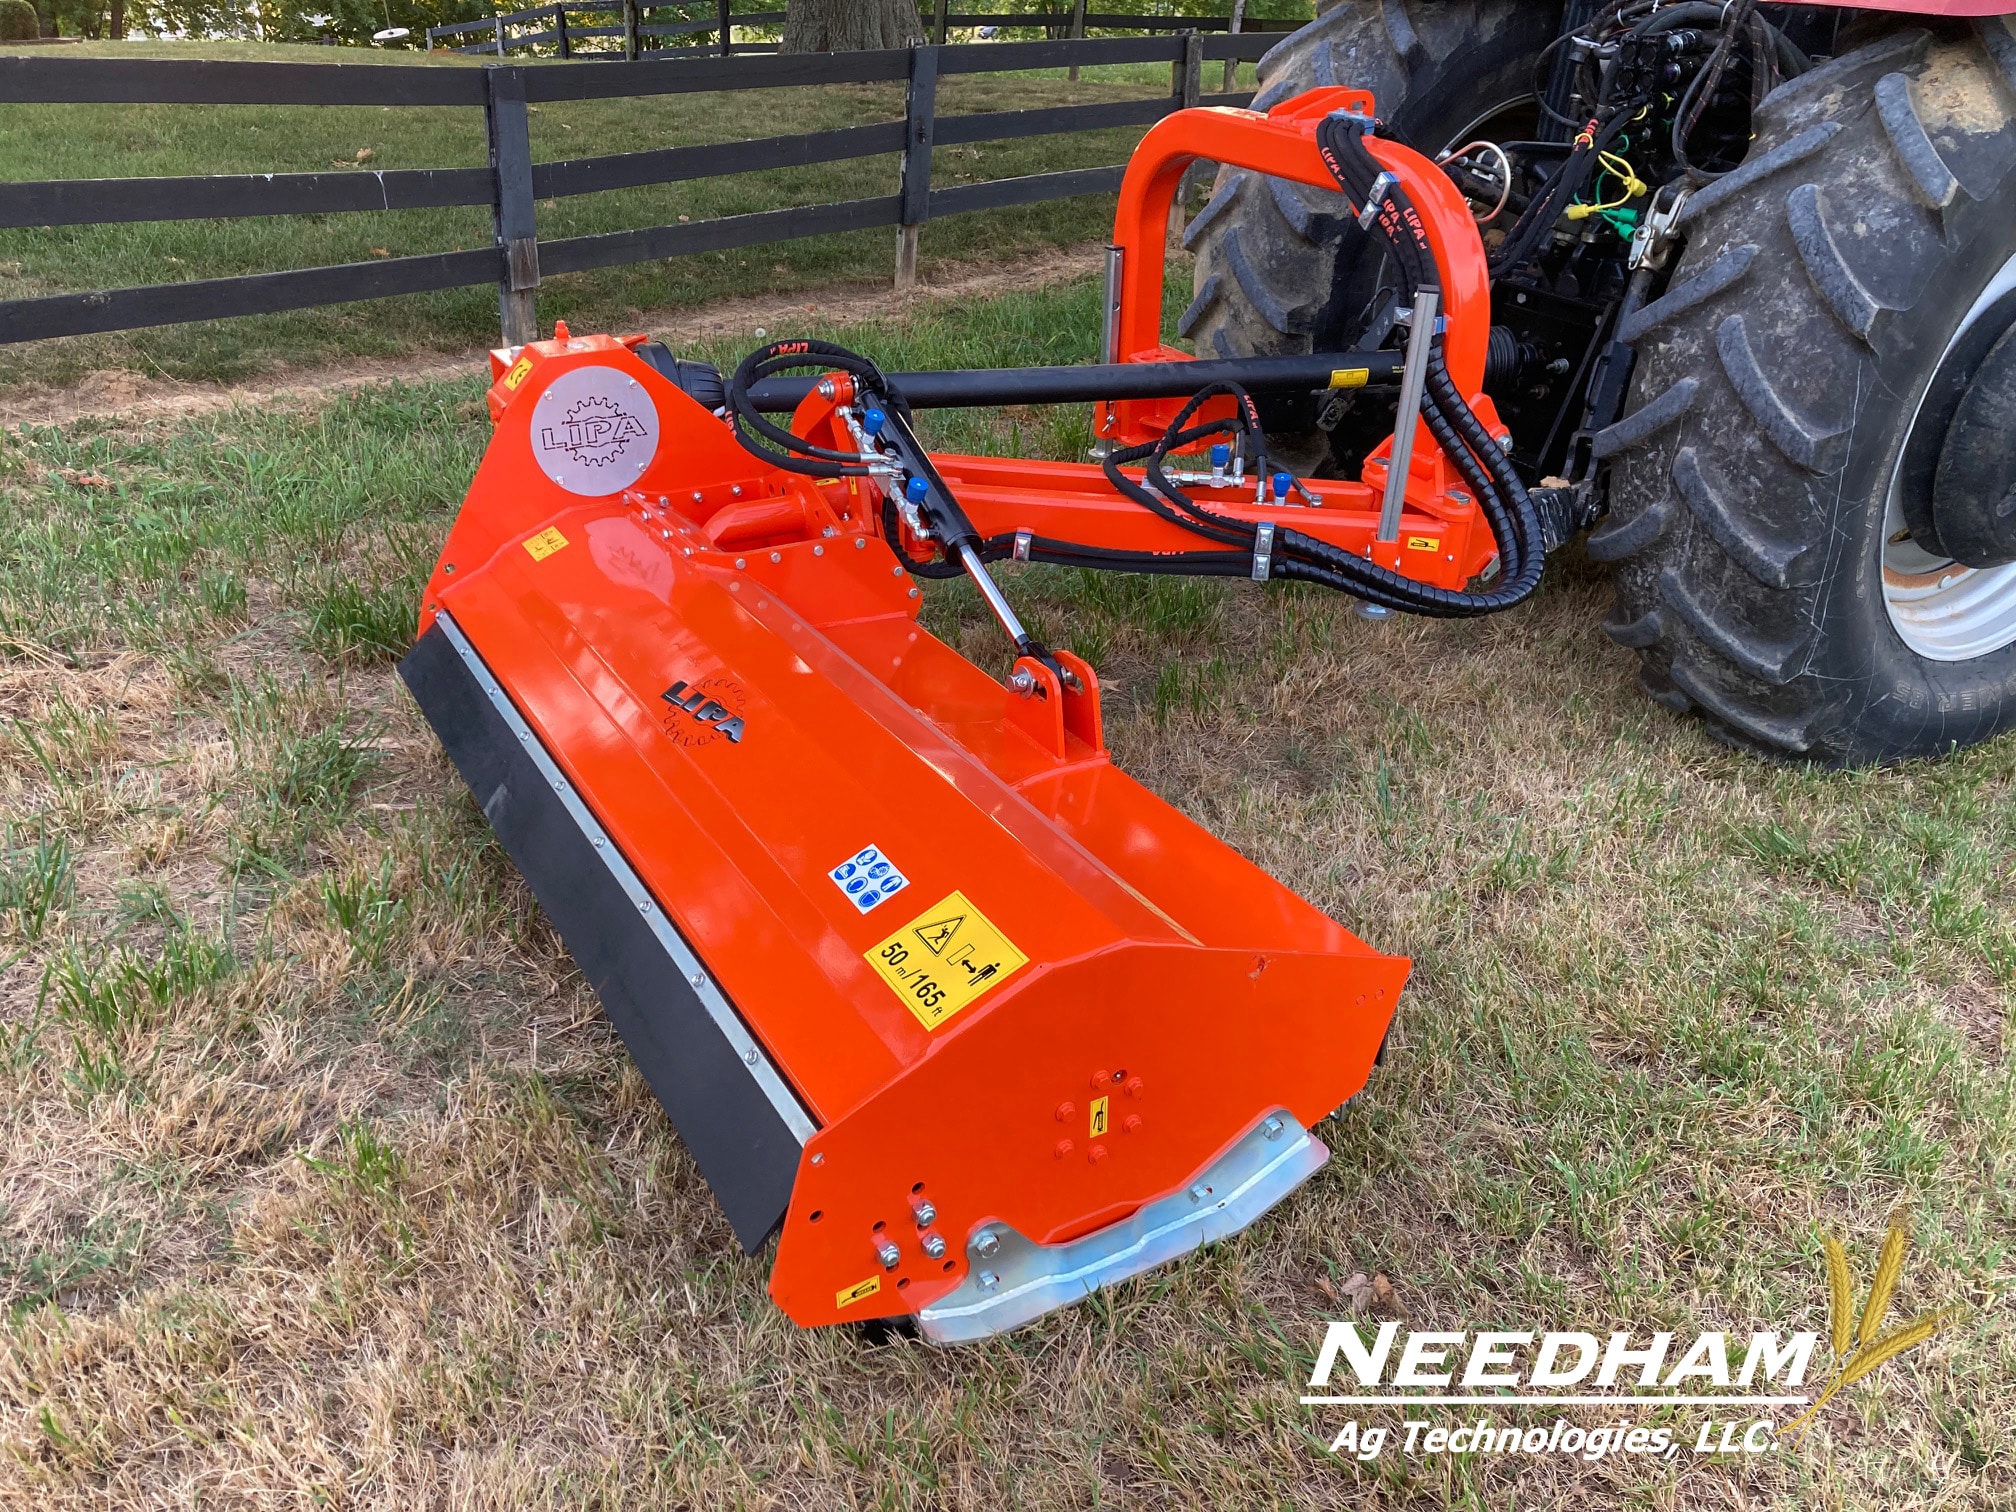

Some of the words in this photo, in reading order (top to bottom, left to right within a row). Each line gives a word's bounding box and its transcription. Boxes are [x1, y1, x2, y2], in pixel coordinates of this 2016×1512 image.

[1382, 198, 1401, 224] IPA
[1403, 207, 1426, 240] LIPA
[778, 342, 809, 356] LIPA
[541, 416, 648, 450] LIPA
[660, 680, 745, 743] LIPA
